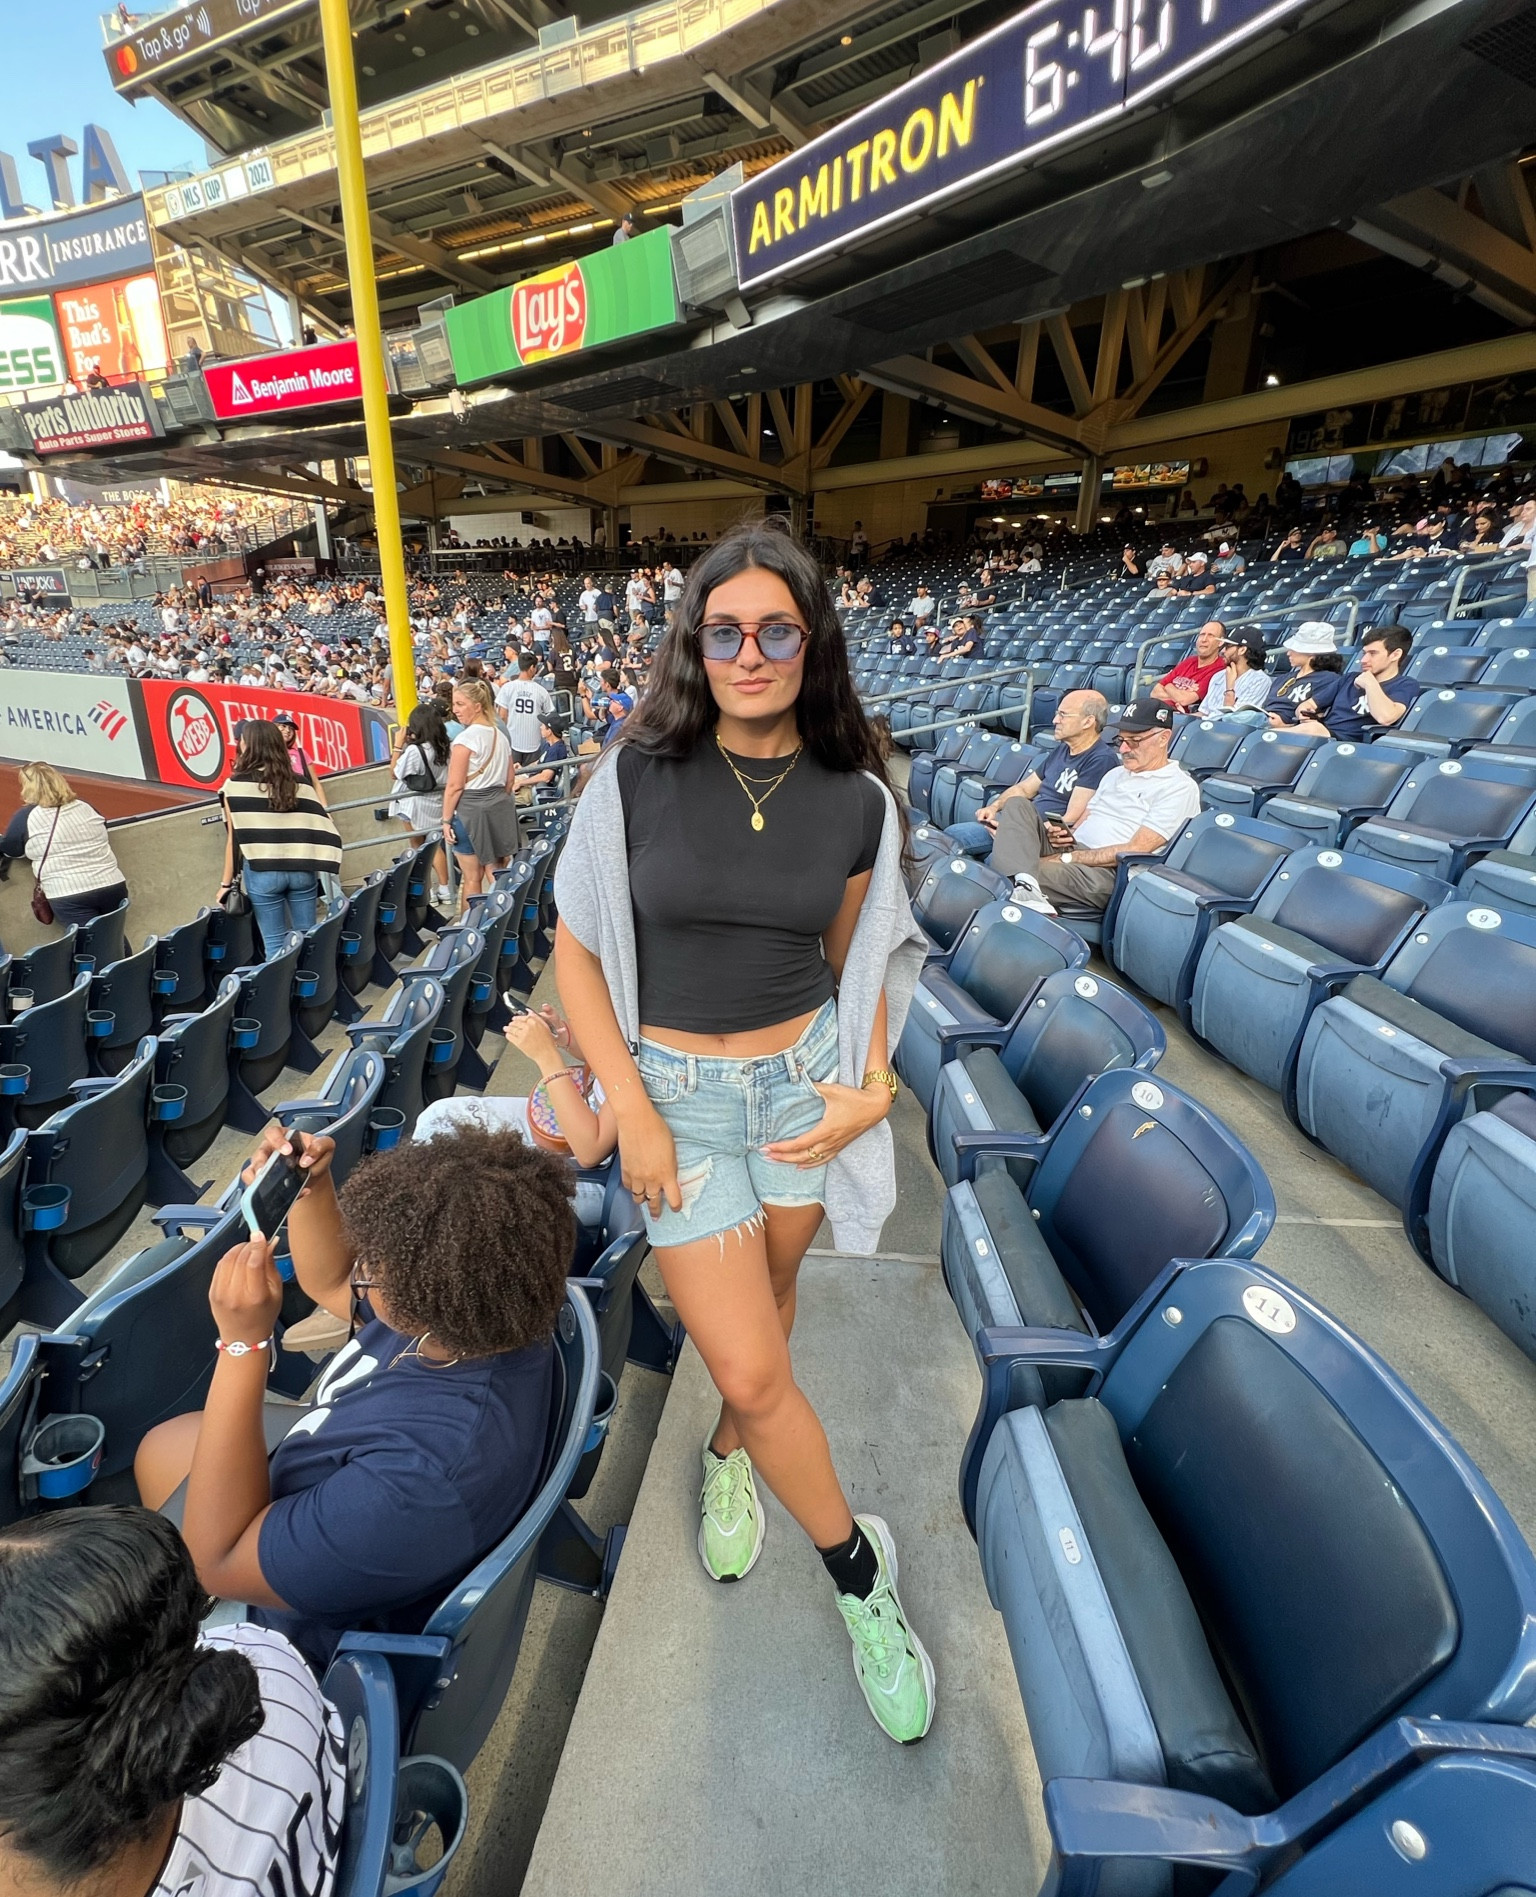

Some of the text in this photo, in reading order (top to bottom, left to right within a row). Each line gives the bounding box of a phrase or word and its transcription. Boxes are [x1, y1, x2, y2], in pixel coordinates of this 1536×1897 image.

[136, 37, 161, 61] Tap
[160, 27, 174, 50] &
[748, 78, 977, 255] ARMITRON
[182, 162, 271, 209] MLS CUP 2021
[52, 219, 148, 264] INSURANCE
[62, 298, 99, 324] This
[517, 271, 581, 353] Lay's
[68, 322, 111, 348] Bud's
[250, 367, 355, 401] Benjamin Moore
[24, 389, 146, 441] Parts Authority
[38, 425, 148, 451] Auto Parts Super Stores
[7, 706, 88, 737] AMERICA
[515, 698, 534, 714] 99
[182, 718, 211, 755] WEBB
[1140, 1089, 1153, 1104] 10
[1254, 1297, 1280, 1323] 11
[1065, 1539, 1075, 1552] 11
